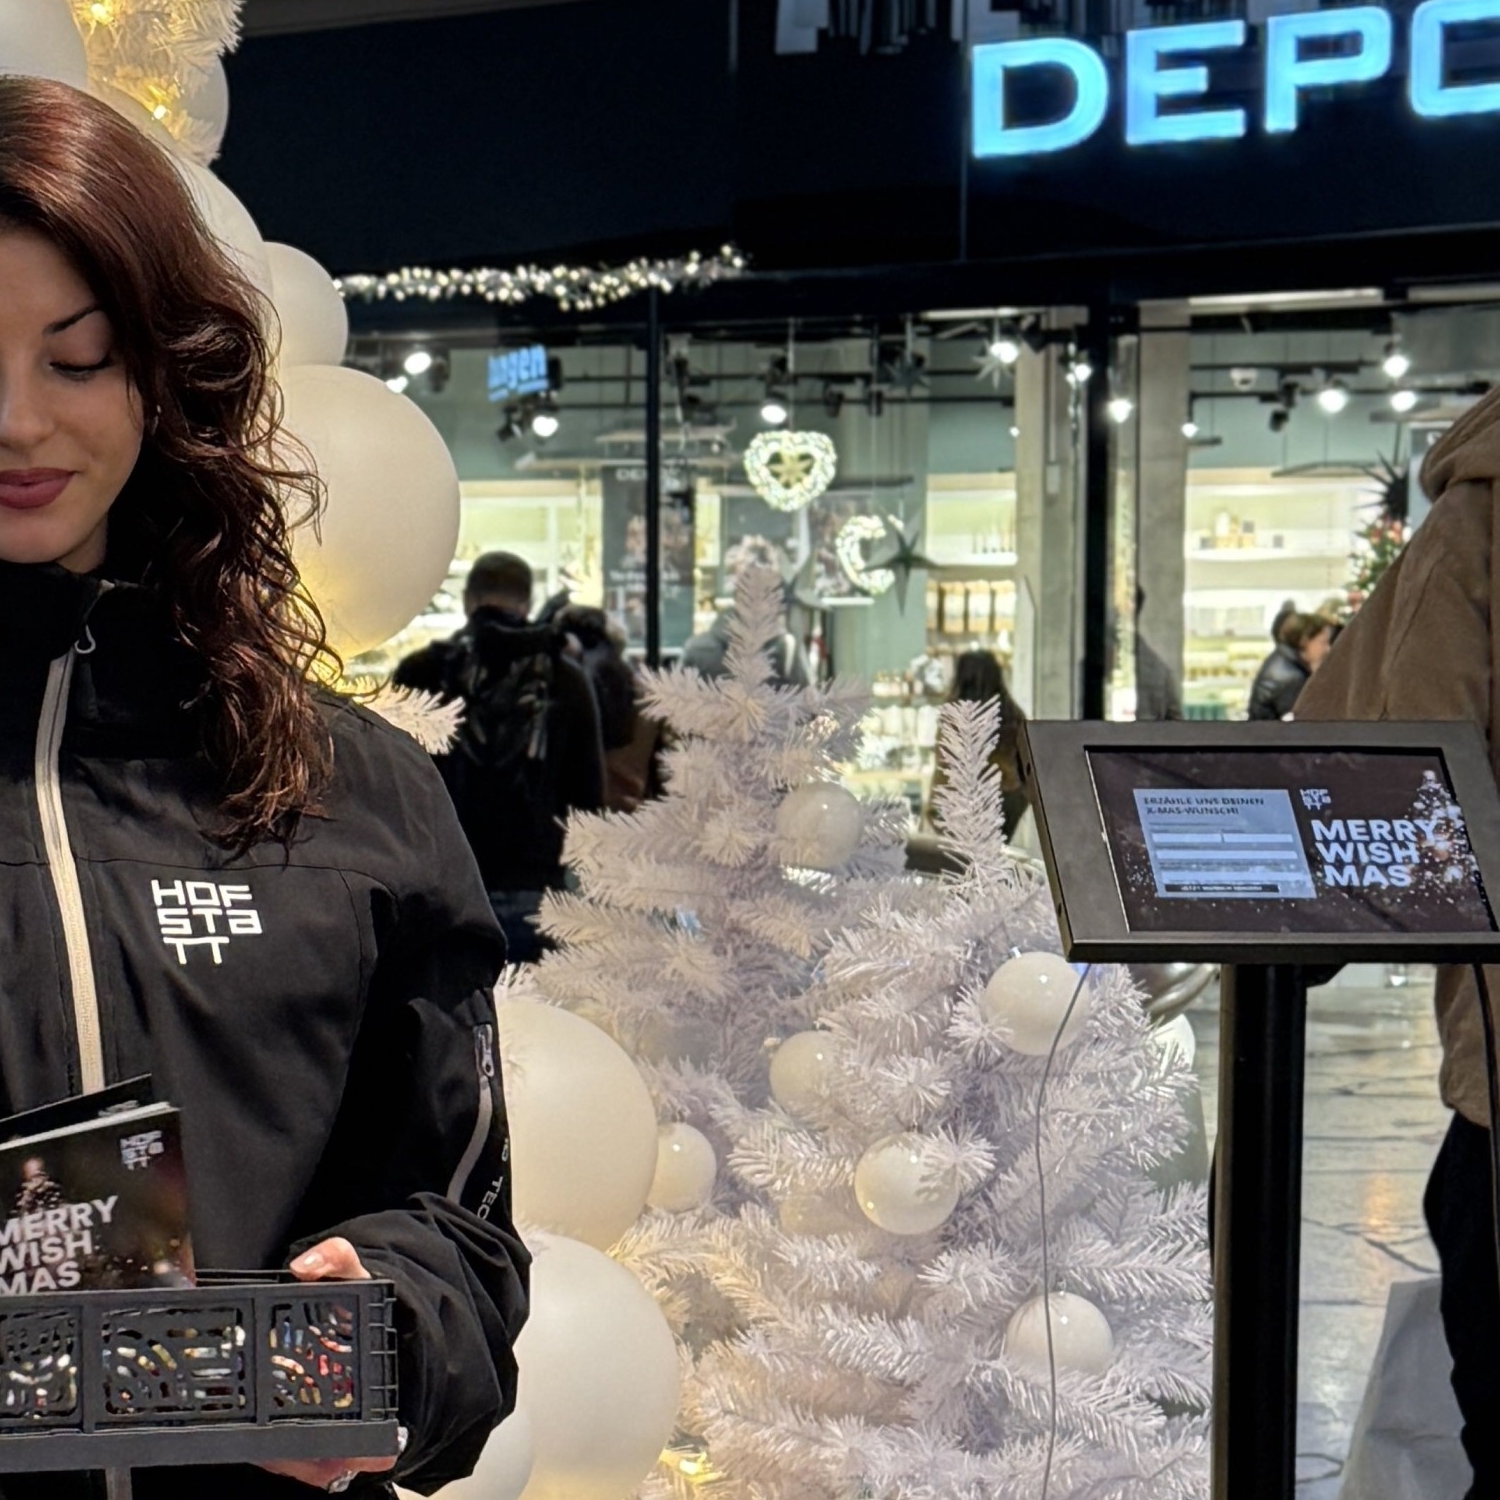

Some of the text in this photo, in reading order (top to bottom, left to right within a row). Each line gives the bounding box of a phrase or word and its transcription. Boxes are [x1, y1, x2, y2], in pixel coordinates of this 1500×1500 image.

[1221, 797, 1265, 806] DEINEN
[1311, 819, 1437, 844] MERRY
[1315, 841, 1420, 864] WISH
[1324, 864, 1412, 887] MAS
[150, 879, 253, 908] HOF
[162, 936, 230, 965] TT
